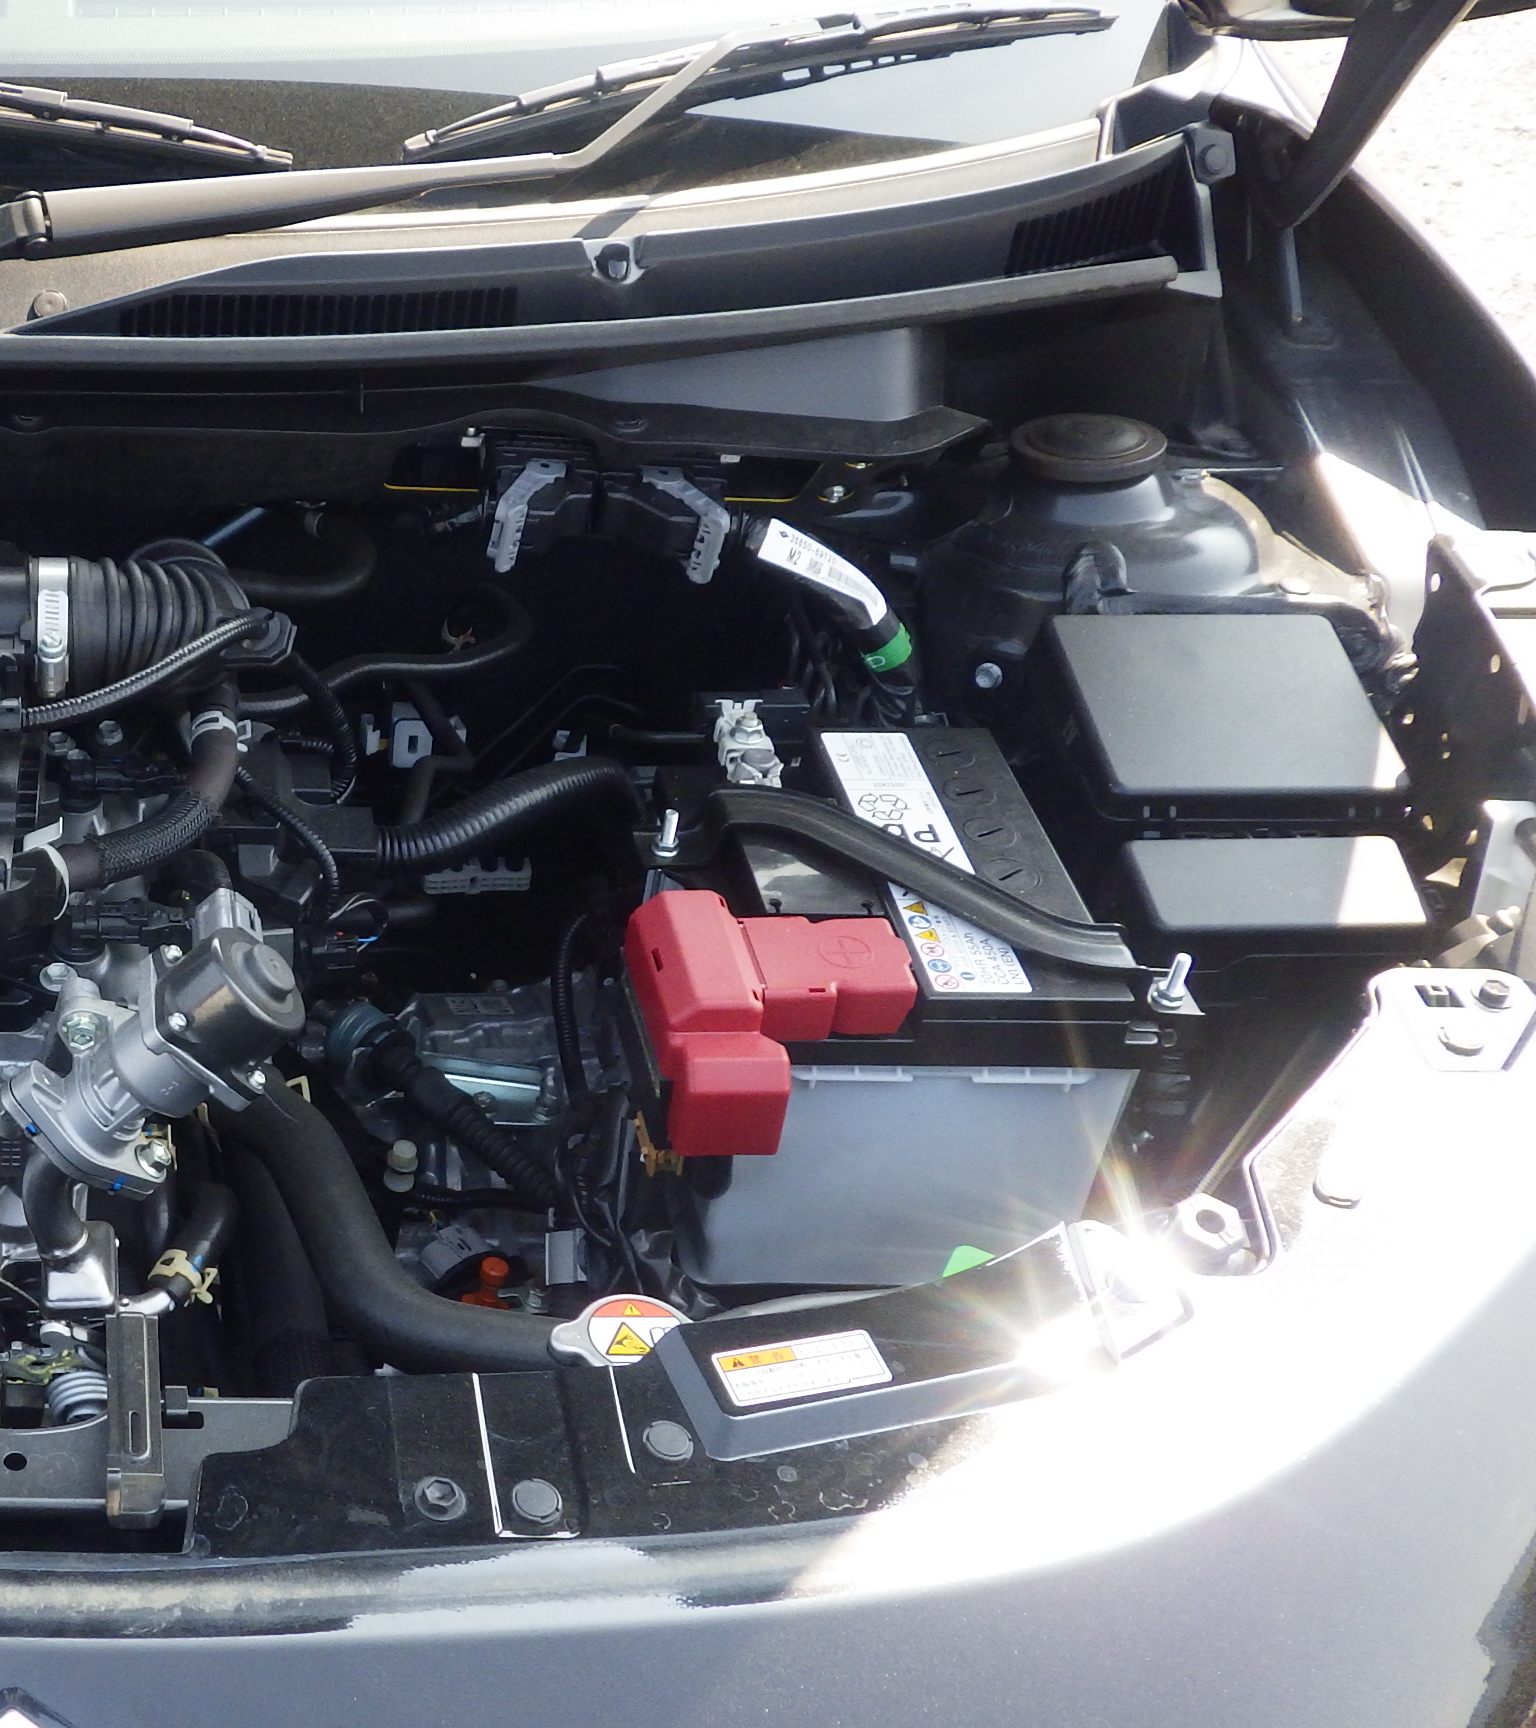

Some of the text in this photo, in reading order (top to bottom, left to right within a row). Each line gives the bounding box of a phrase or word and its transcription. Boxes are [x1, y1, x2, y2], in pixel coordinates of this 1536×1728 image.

[786, 547, 802, 566] M2
[965, 932, 996, 985] 20HR 55Ah
[980, 938, 1010, 985] CCA 450A
[997, 947, 1015, 966] (EN)
